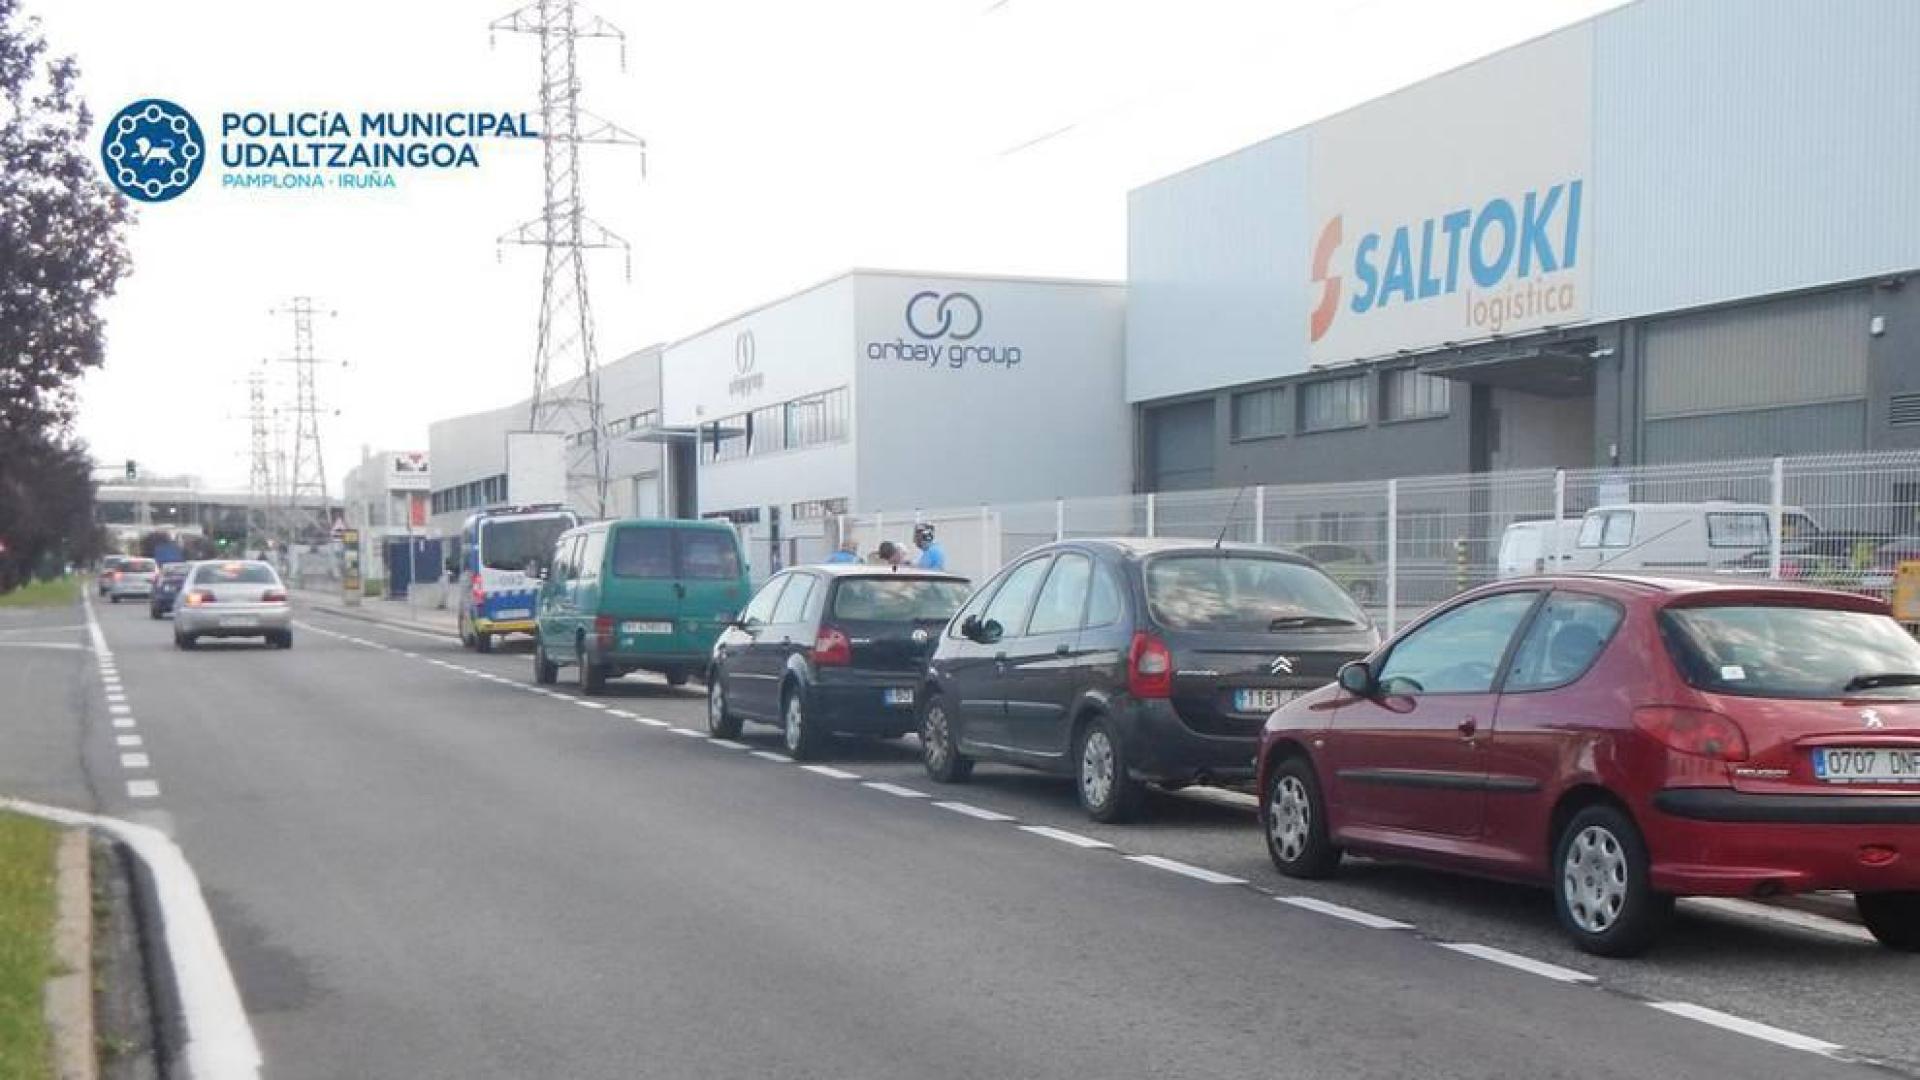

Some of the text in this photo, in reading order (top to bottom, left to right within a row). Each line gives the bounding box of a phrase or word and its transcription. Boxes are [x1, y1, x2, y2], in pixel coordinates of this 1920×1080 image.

[1350, 179, 1583, 315] SALTOKI
[867, 337, 1022, 369] oribay group
[1829, 751, 1876, 775] 0707
